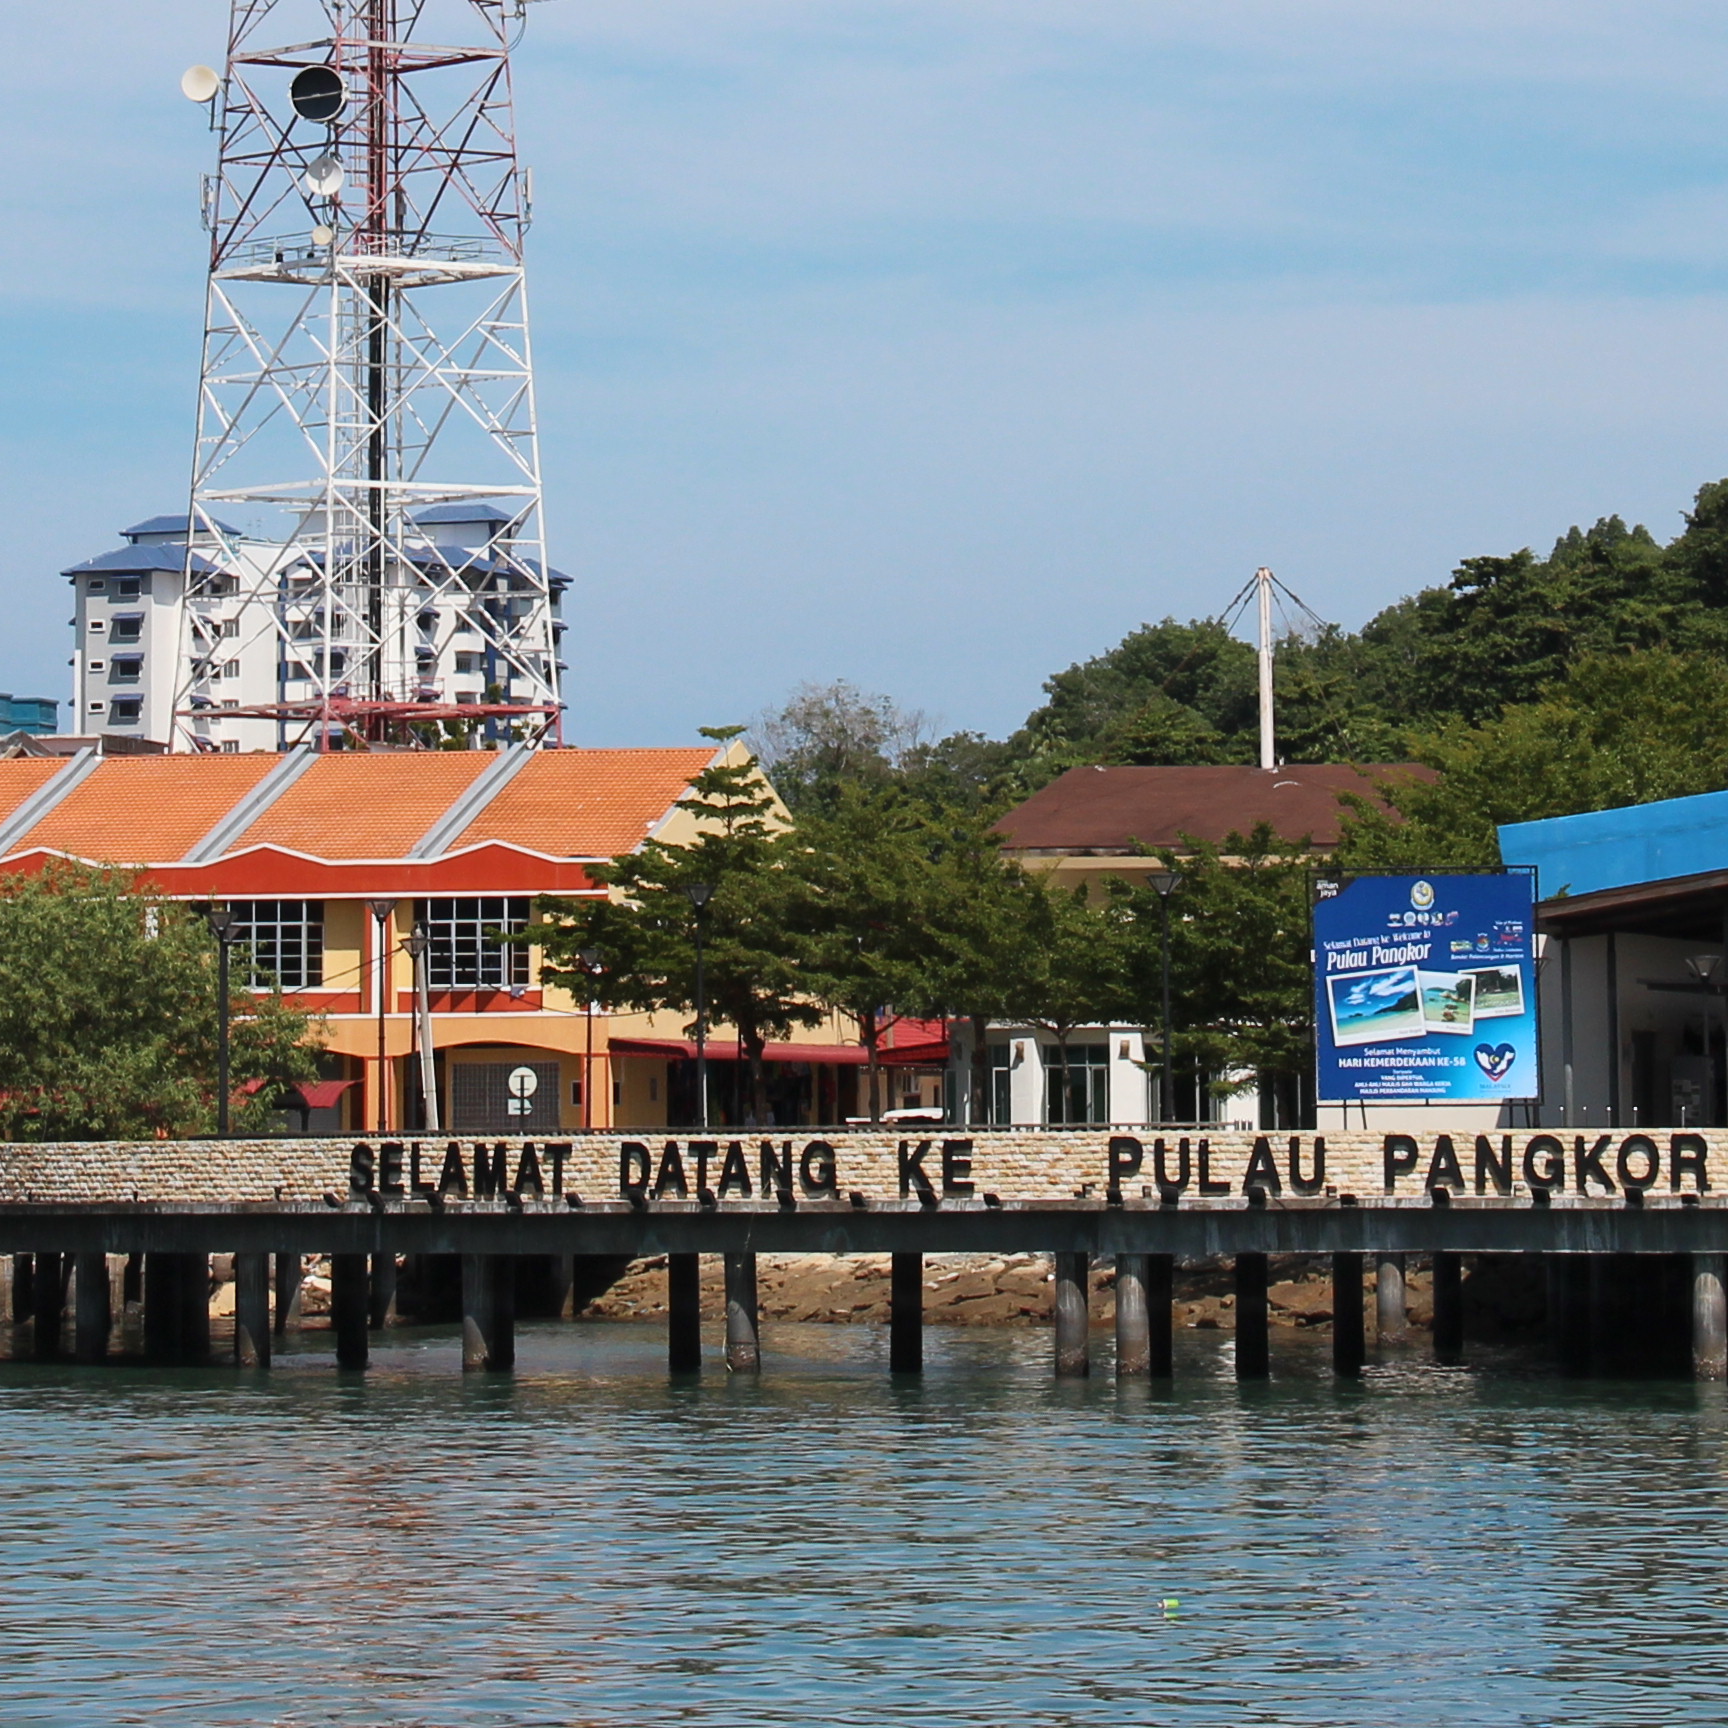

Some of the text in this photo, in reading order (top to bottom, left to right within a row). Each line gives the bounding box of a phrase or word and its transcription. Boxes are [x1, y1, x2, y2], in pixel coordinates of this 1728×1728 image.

[1316, 881, 1339, 890] aman
[1323, 939, 1352, 950] Selamat
[1326, 949, 1368, 971] Pulau
[1371, 942, 1432, 966] Pangkor
[1363, 1047, 1441, 1058] Selamat Menyambut
[1338, 1056, 1466, 1068] HARI KEMERDEKAAN KE-58
[349, 1133, 1710, 1198] SELAMAT DATANG KE PULAU PANGKOR
